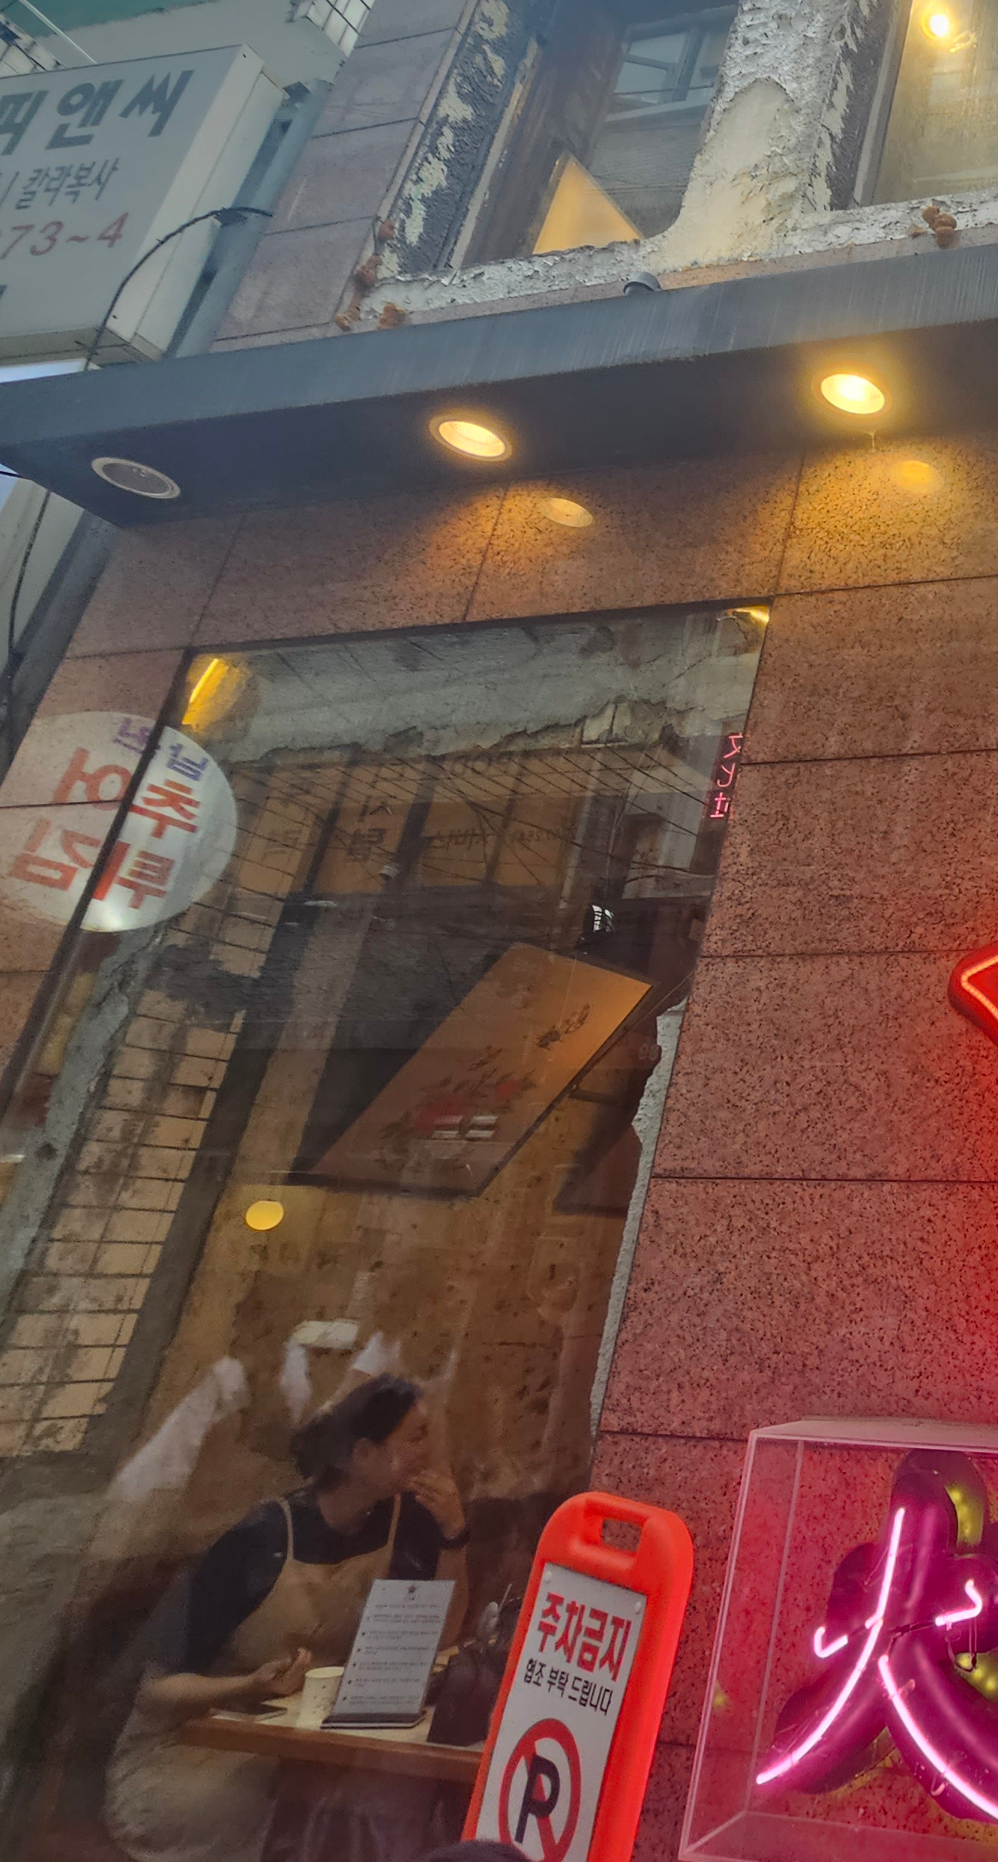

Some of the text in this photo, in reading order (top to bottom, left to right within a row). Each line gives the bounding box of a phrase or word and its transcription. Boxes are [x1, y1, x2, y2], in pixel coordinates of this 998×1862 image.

[536, 1591, 632, 1682] 주차금지
[523, 1657, 614, 1717] 협조 부탁 드립니다
